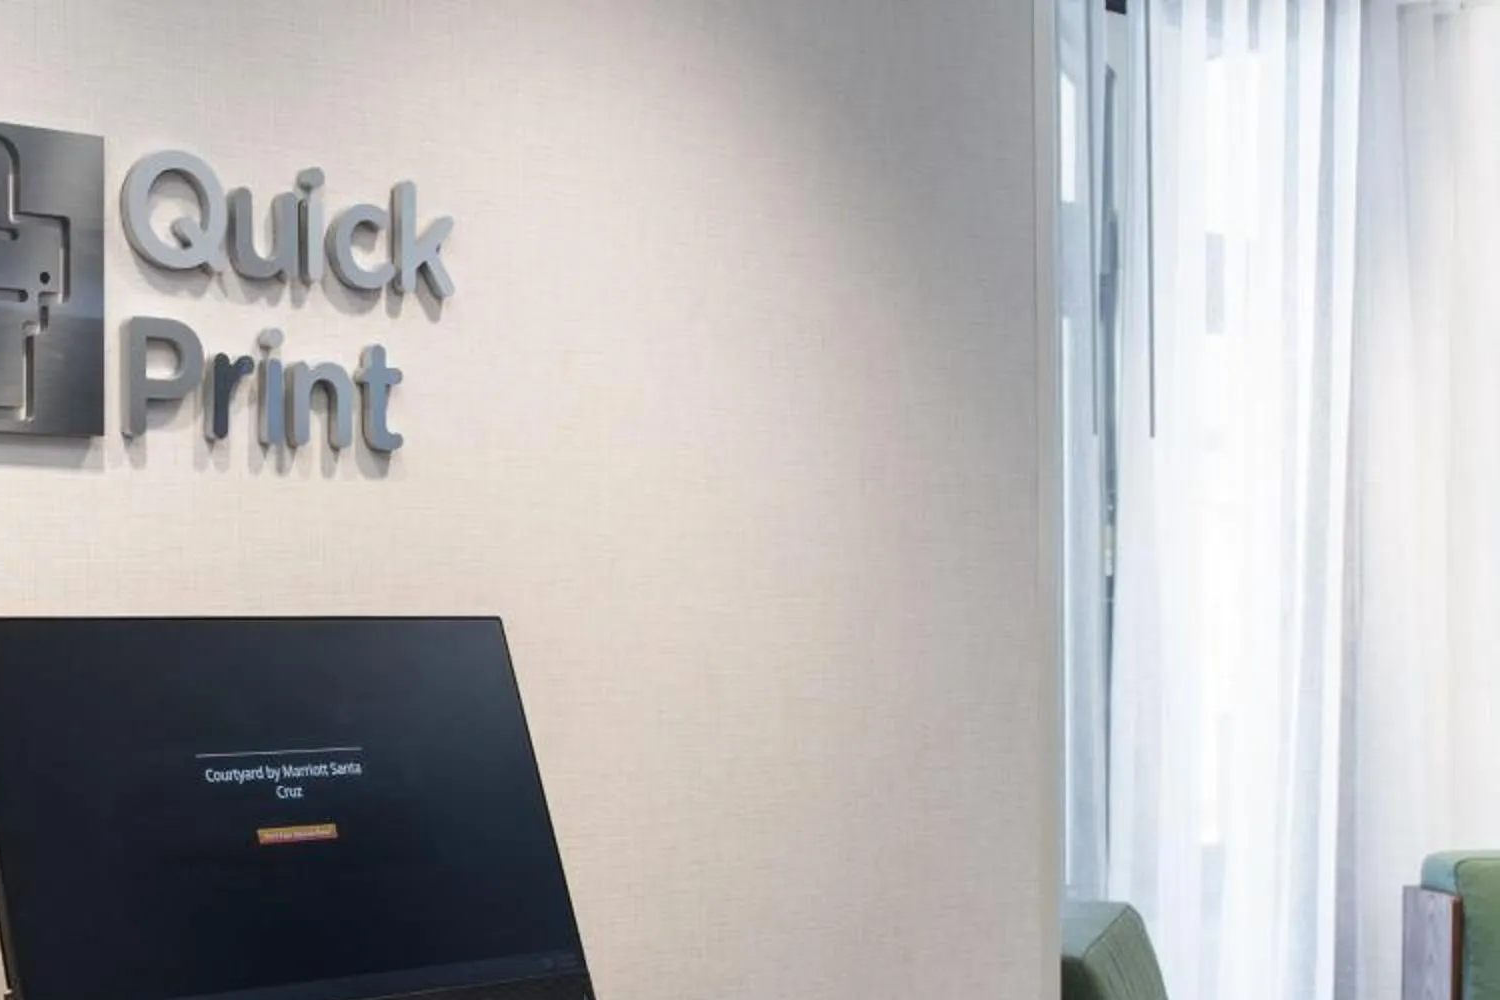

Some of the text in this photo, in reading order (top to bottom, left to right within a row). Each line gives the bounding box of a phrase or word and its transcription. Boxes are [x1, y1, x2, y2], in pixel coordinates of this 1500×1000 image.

[119, 149, 454, 301] Quick
[120, 316, 403, 453] Print
[205, 761, 363, 784] Courtyard by Marriott Santa
[275, 785, 304, 799] Cruz
